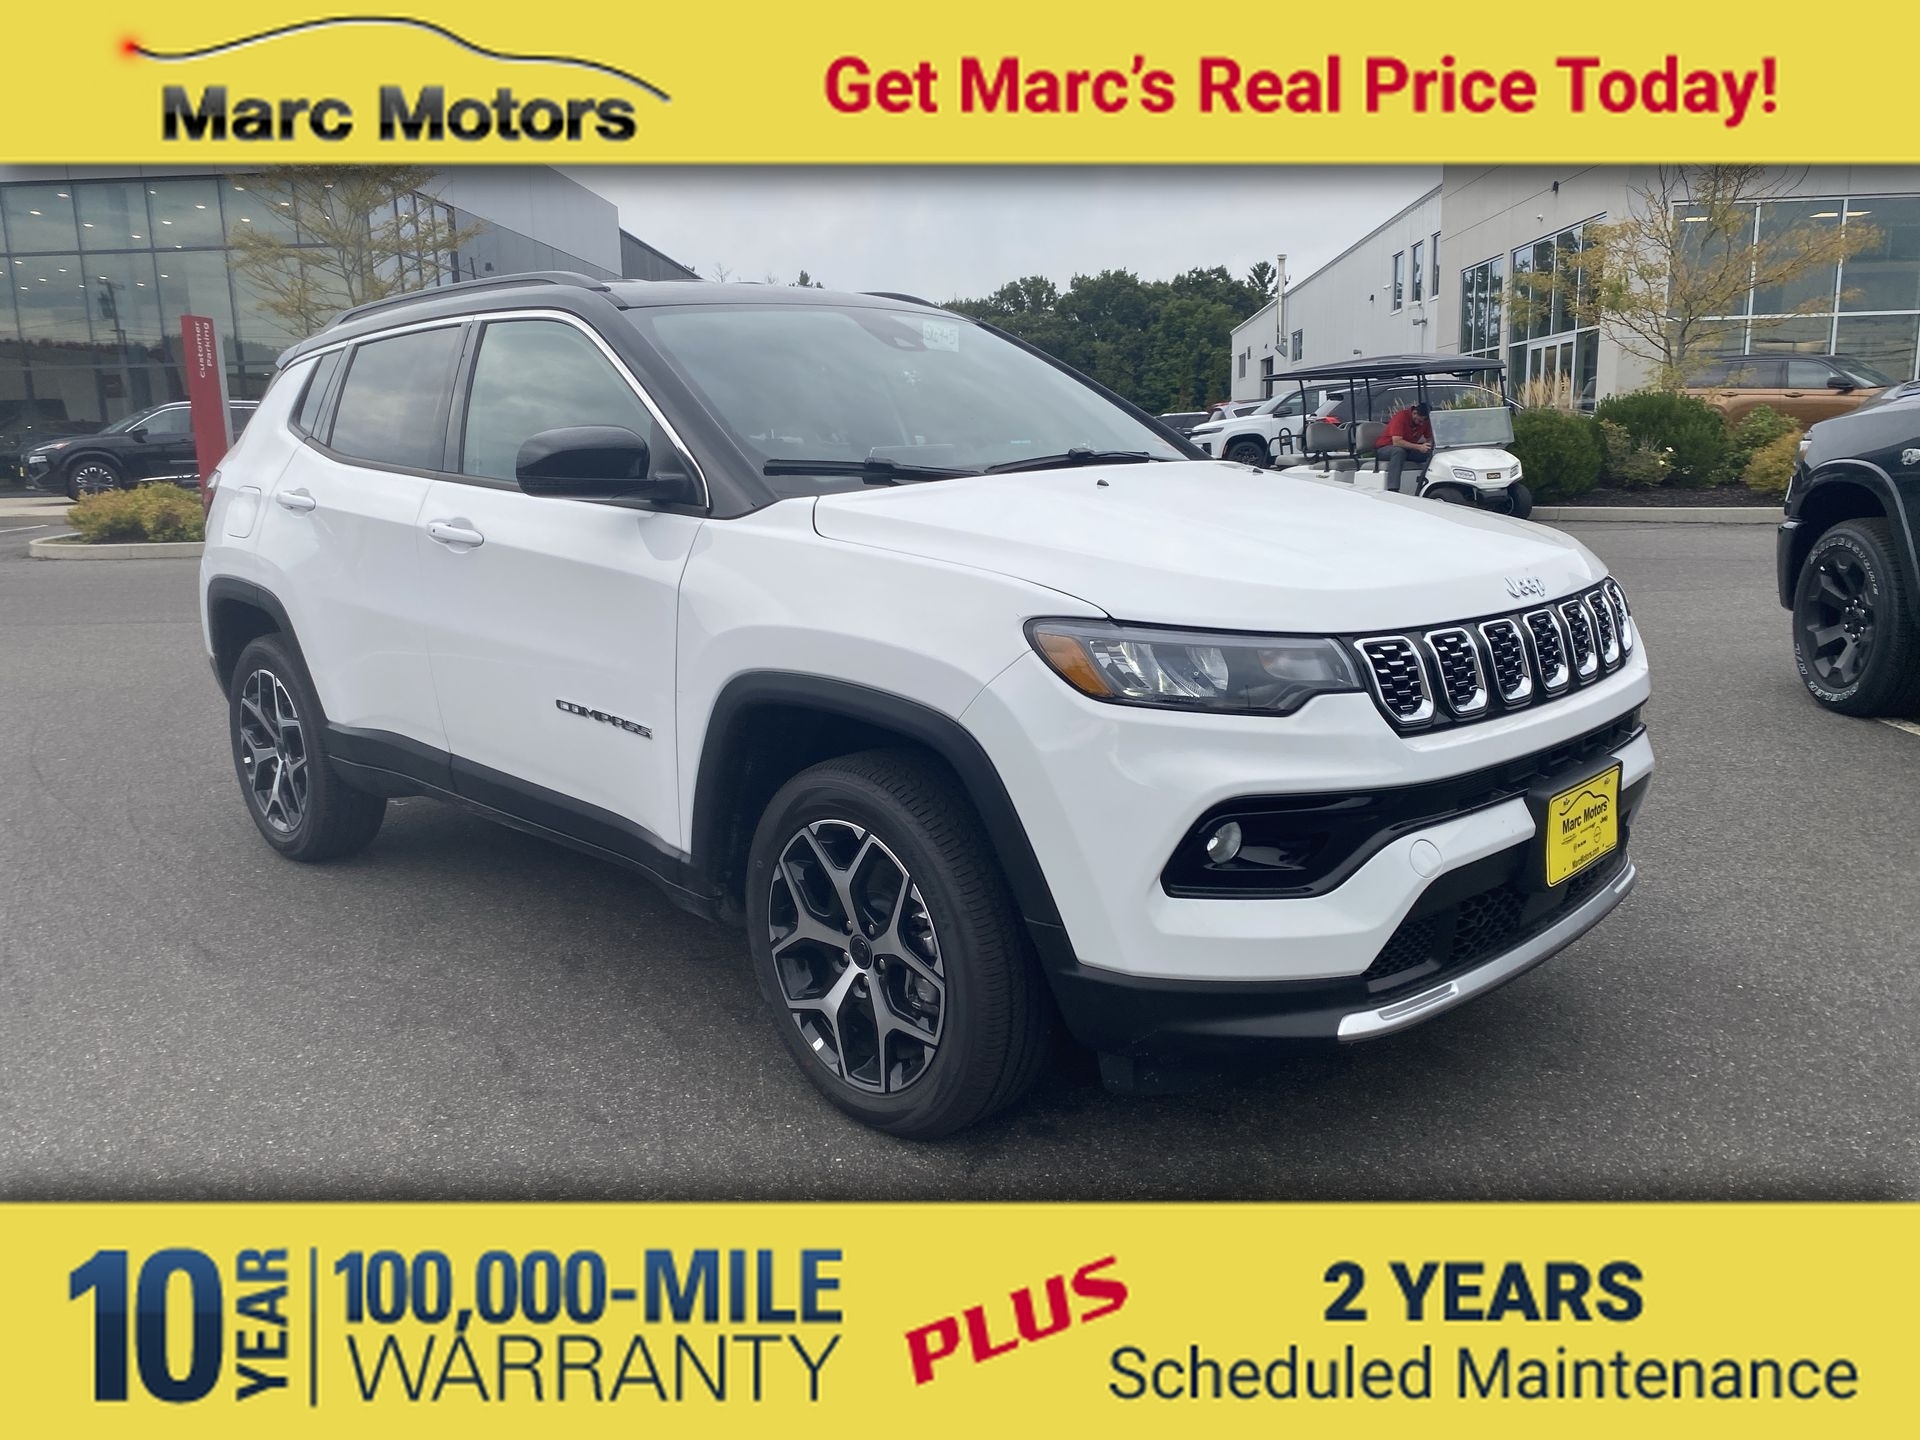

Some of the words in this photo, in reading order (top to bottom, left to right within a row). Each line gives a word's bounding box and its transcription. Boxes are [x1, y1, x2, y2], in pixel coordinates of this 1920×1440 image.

[194, 320, 206, 378] Customer
[203, 322, 213, 367] Parking
[1504, 576, 1546, 600] Jeep
[555, 699, 653, 740] COMPASS
[1562, 816, 1582, 834] Marc
[1583, 800, 1608, 824] Motors
